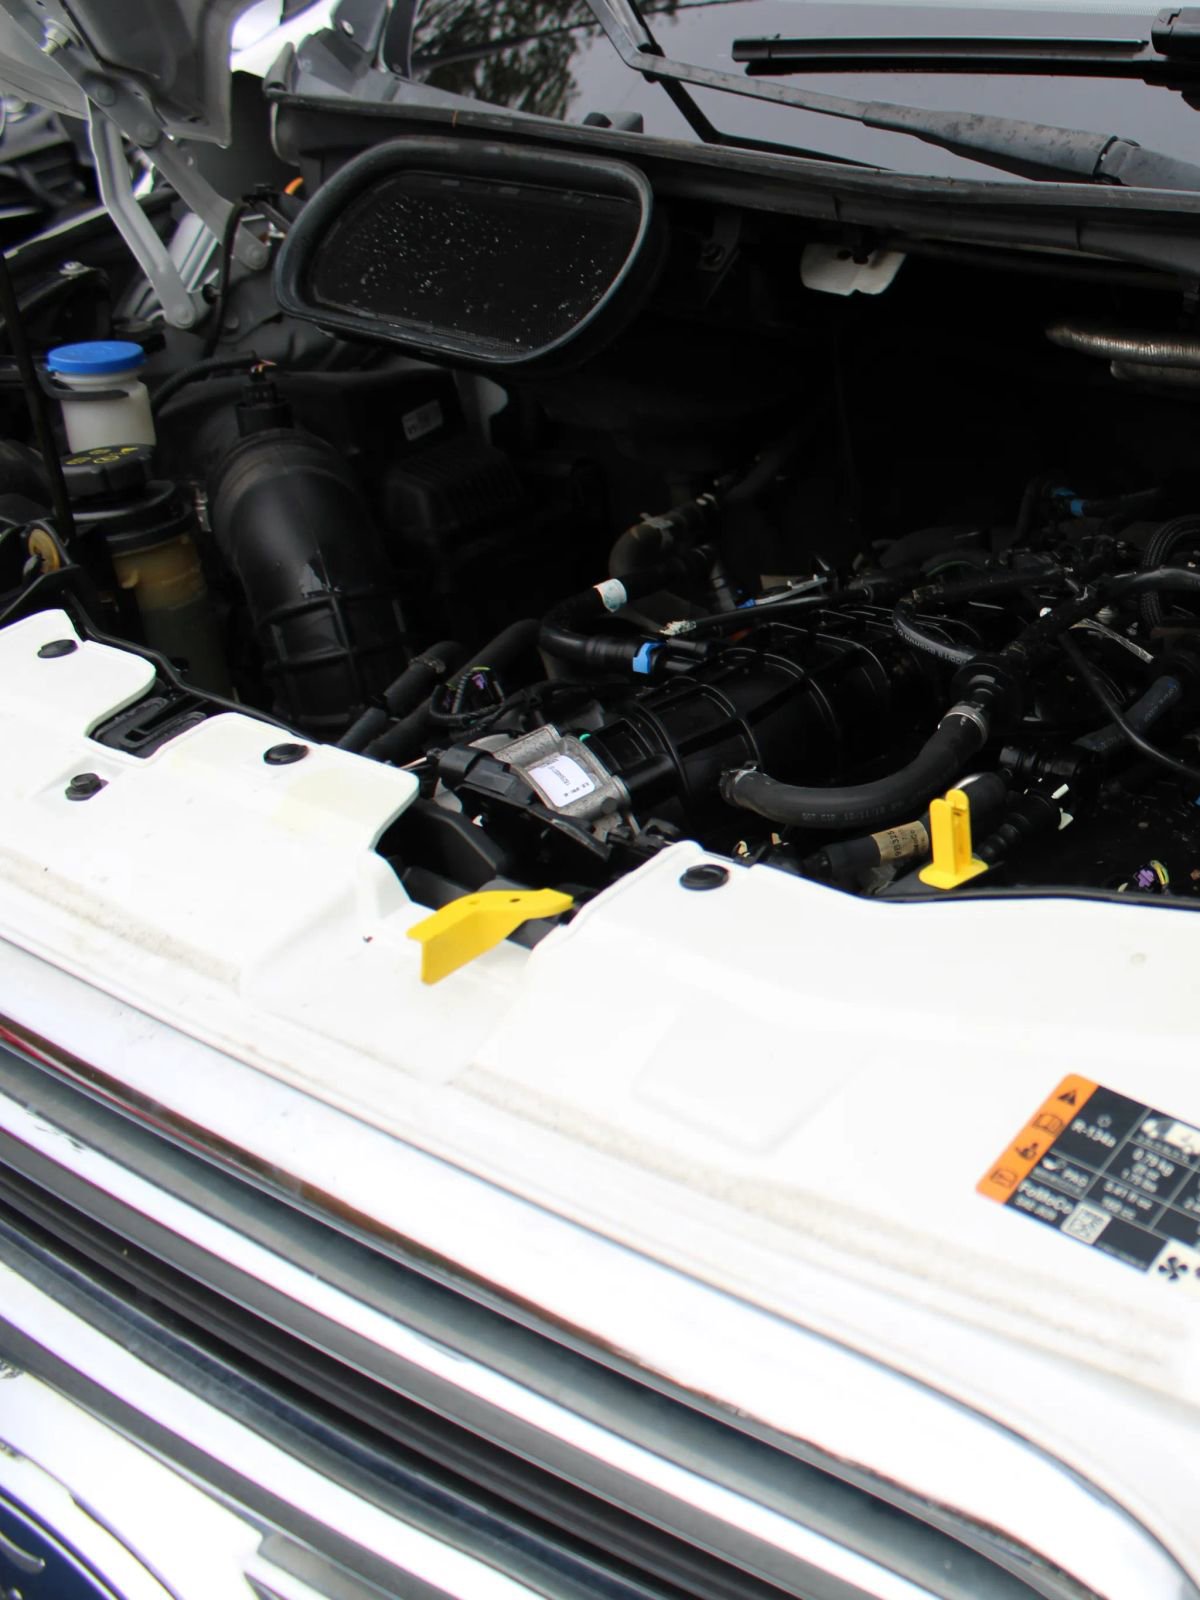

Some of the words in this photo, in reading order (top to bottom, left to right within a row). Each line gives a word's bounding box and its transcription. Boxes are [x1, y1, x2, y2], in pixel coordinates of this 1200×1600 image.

[1071, 1119, 1116, 1148] R-134a
[1157, 1159, 1174, 1177] kg
[1018, 1180, 1074, 1215] FoMoCo
